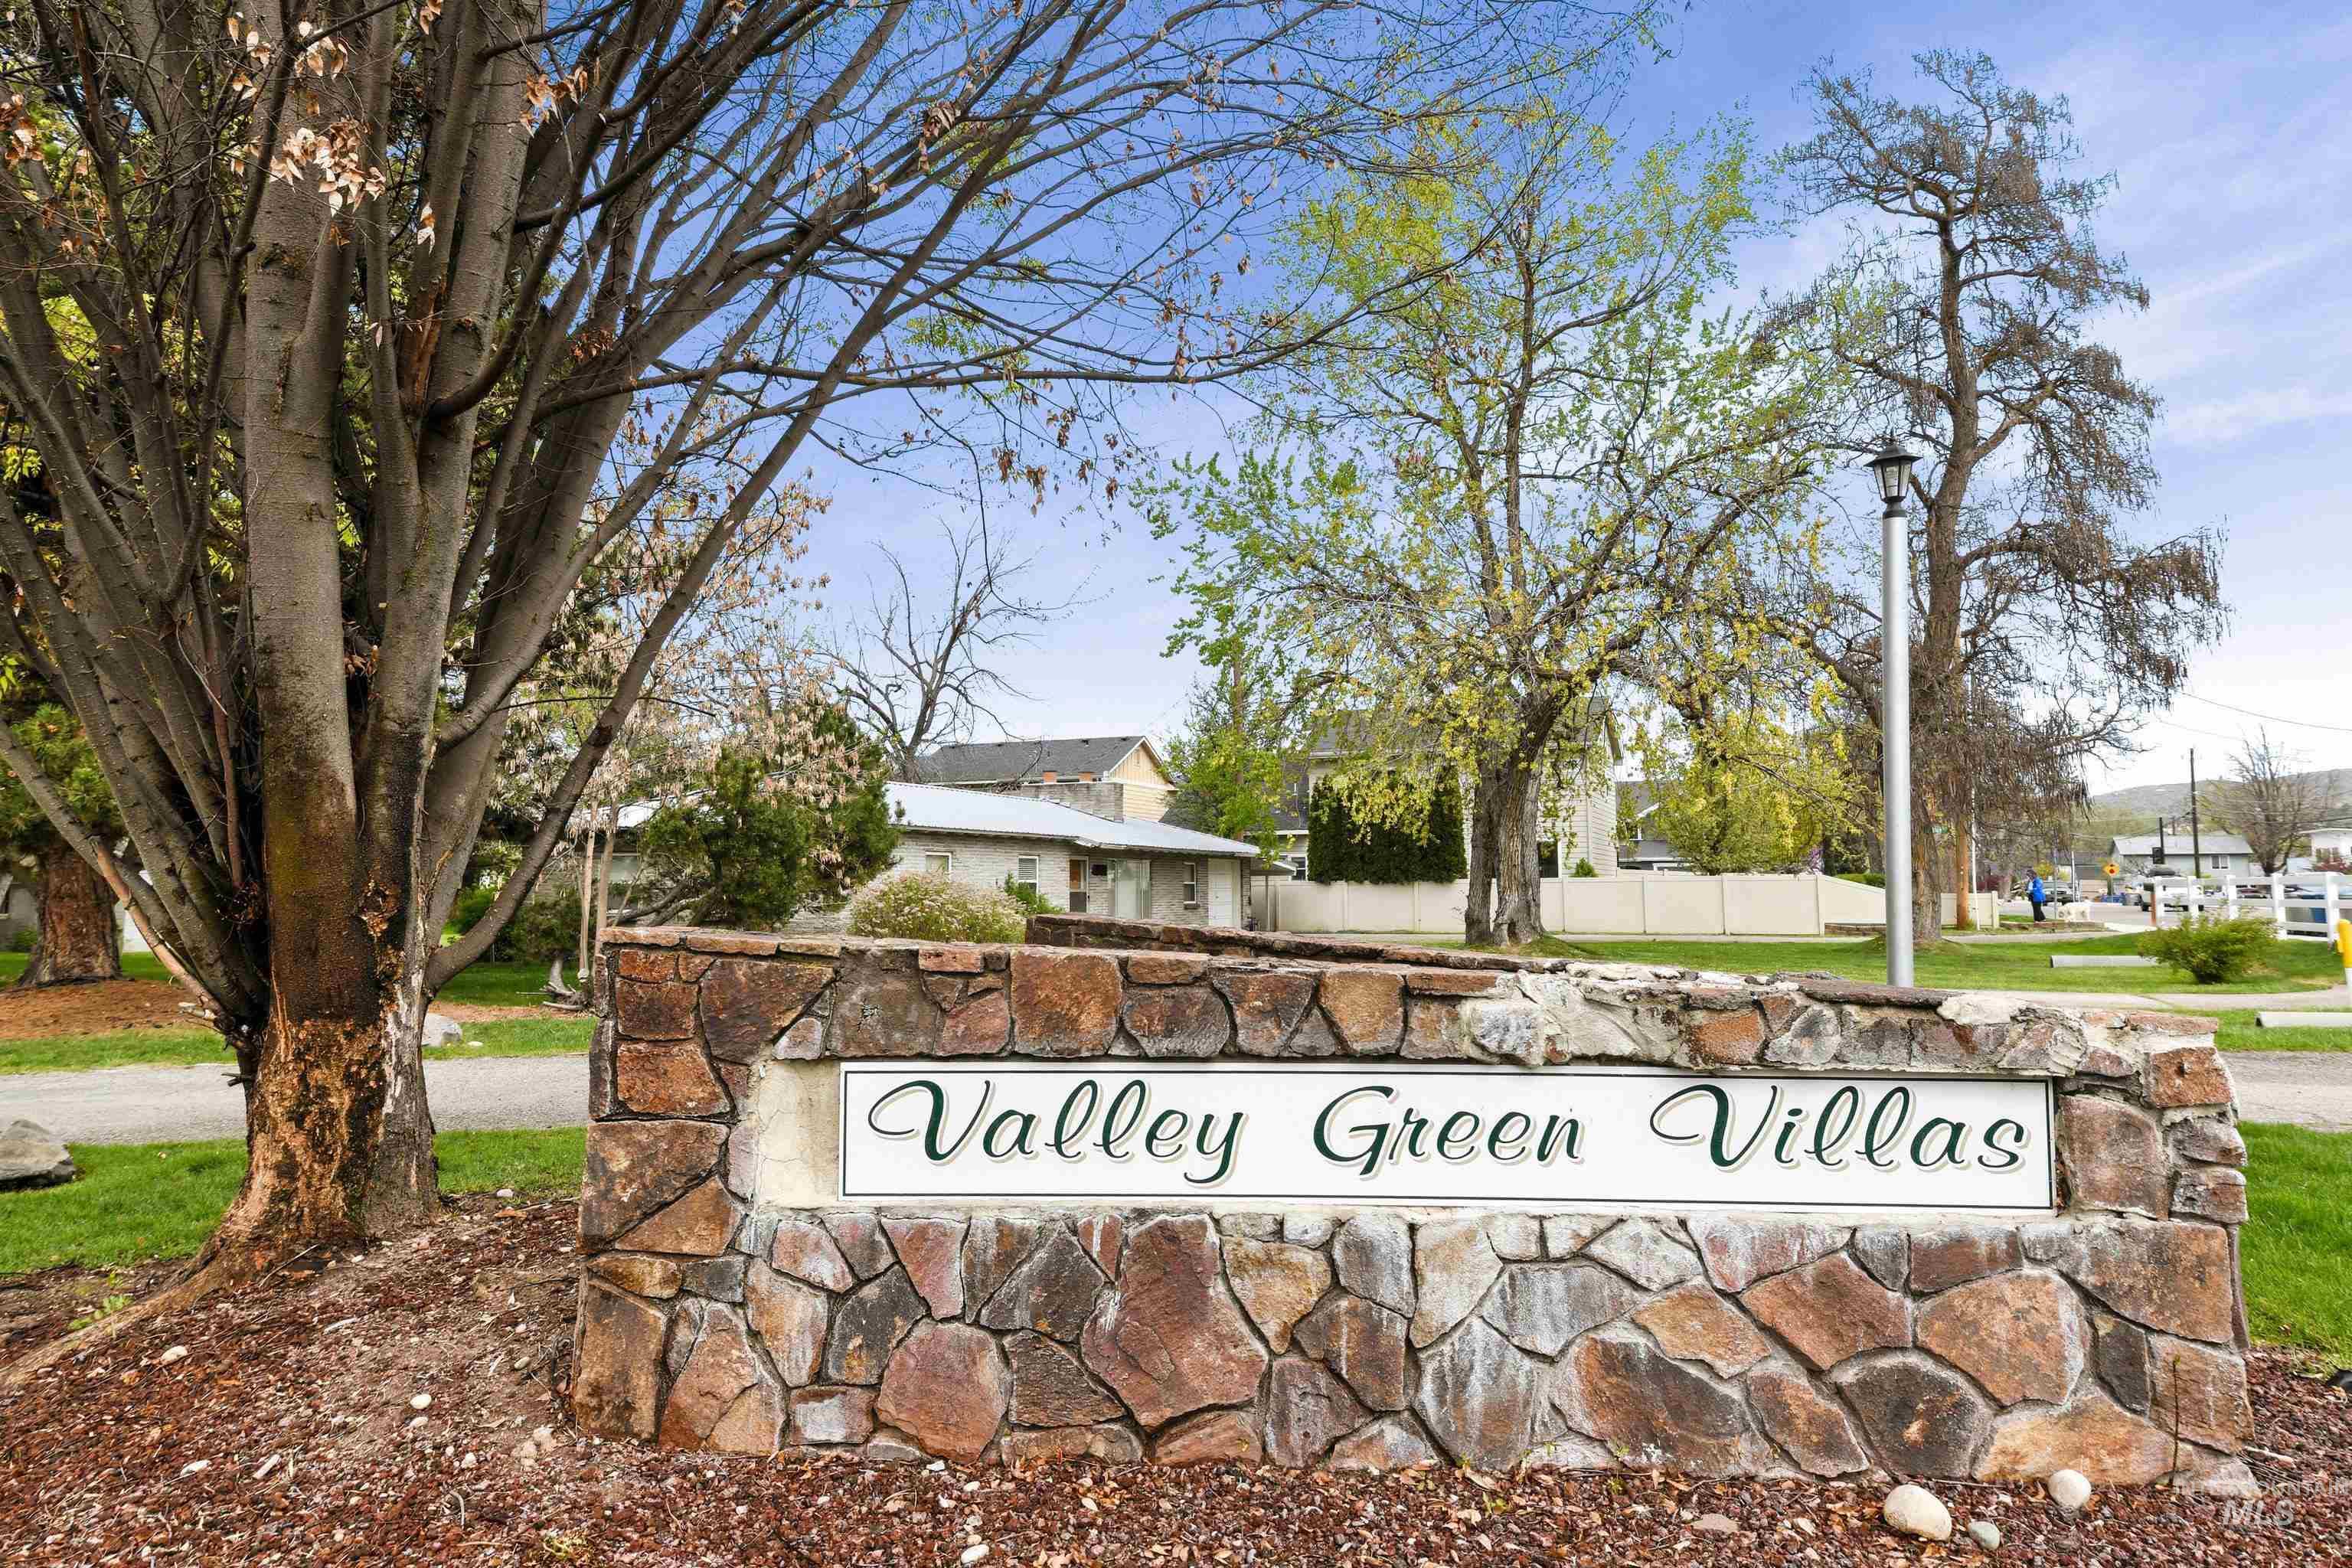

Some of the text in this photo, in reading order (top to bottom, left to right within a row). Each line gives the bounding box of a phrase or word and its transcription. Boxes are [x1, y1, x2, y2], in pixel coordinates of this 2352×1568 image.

[867, 1079, 2028, 1185] Valley Green Villas
